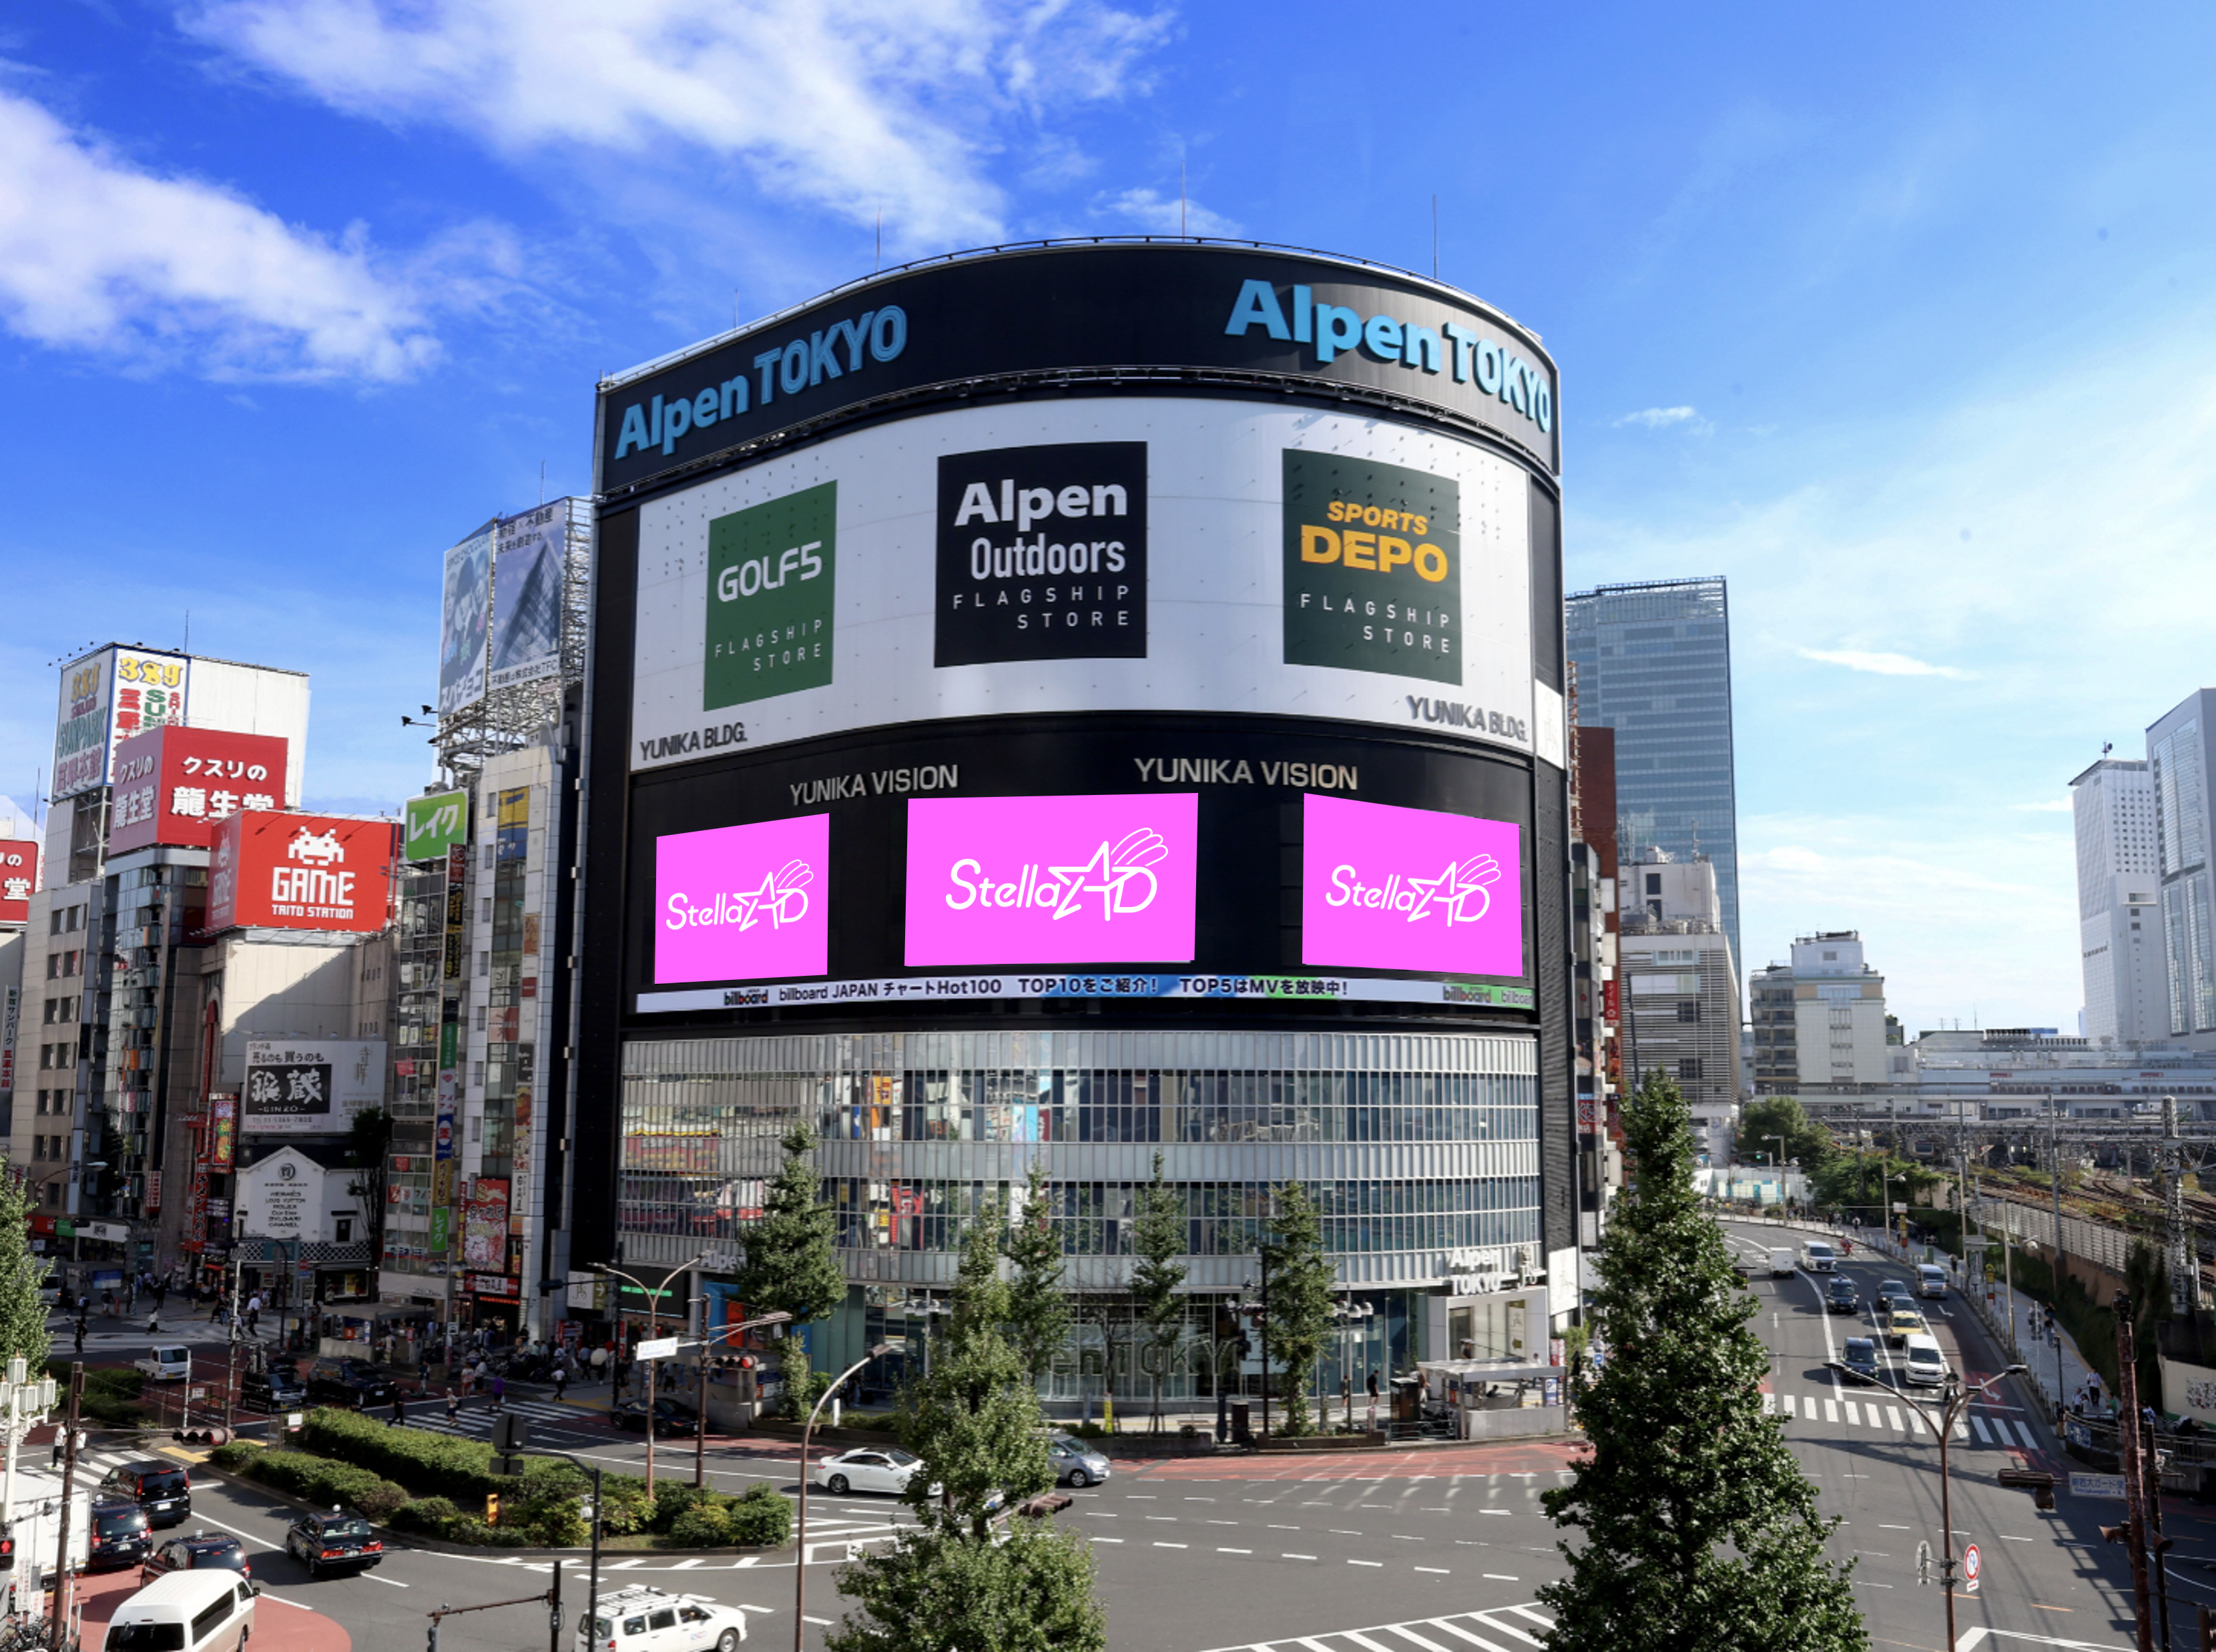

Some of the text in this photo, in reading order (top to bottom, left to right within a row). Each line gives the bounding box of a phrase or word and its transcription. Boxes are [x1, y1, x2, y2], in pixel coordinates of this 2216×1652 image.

[1224, 278, 1551, 433] Alpen TOKYO
[615, 304, 908, 460] Alpen TOKYO
[953, 479, 1128, 533] Alpen
[1326, 501, 1428, 536] SPORTS
[971, 533, 1126, 580] Outdoors
[1300, 524, 1448, 583] DEPO
[717, 541, 822, 602] GOLF5
[952, 585, 1129, 610] FLAGSHIP
[1300, 593, 1450, 628] FLAGSHIP
[1017, 610, 1129, 629] STORE
[714, 619, 822, 659] FLAGSHIP
[1363, 625, 1450, 653] STORE
[119, 656, 183, 688] 389
[753, 643, 822, 671] STORE
[1405, 694, 1529, 742] YUNIKA BLDG.
[640, 722, 748, 761] YUNIKA BLDG.
[119, 755, 156, 784] クスリの
[182, 756, 268, 782] クスリの
[790, 764, 958, 806] YUNIKA VISION
[1134, 758, 1358, 790] YUNIKA VISION
[408, 804, 459, 842] レイク
[272, 867, 356, 906] GAME
[272, 904, 354, 920] TAITO STATION
[779, 986, 829, 1001] billboard
[832, 982, 878, 999] JAPAN
[433, 1214, 445, 1244] レイク
[1450, 1248, 1502, 1271] Alpen
[1450, 1272, 1502, 1296] TOKYO
